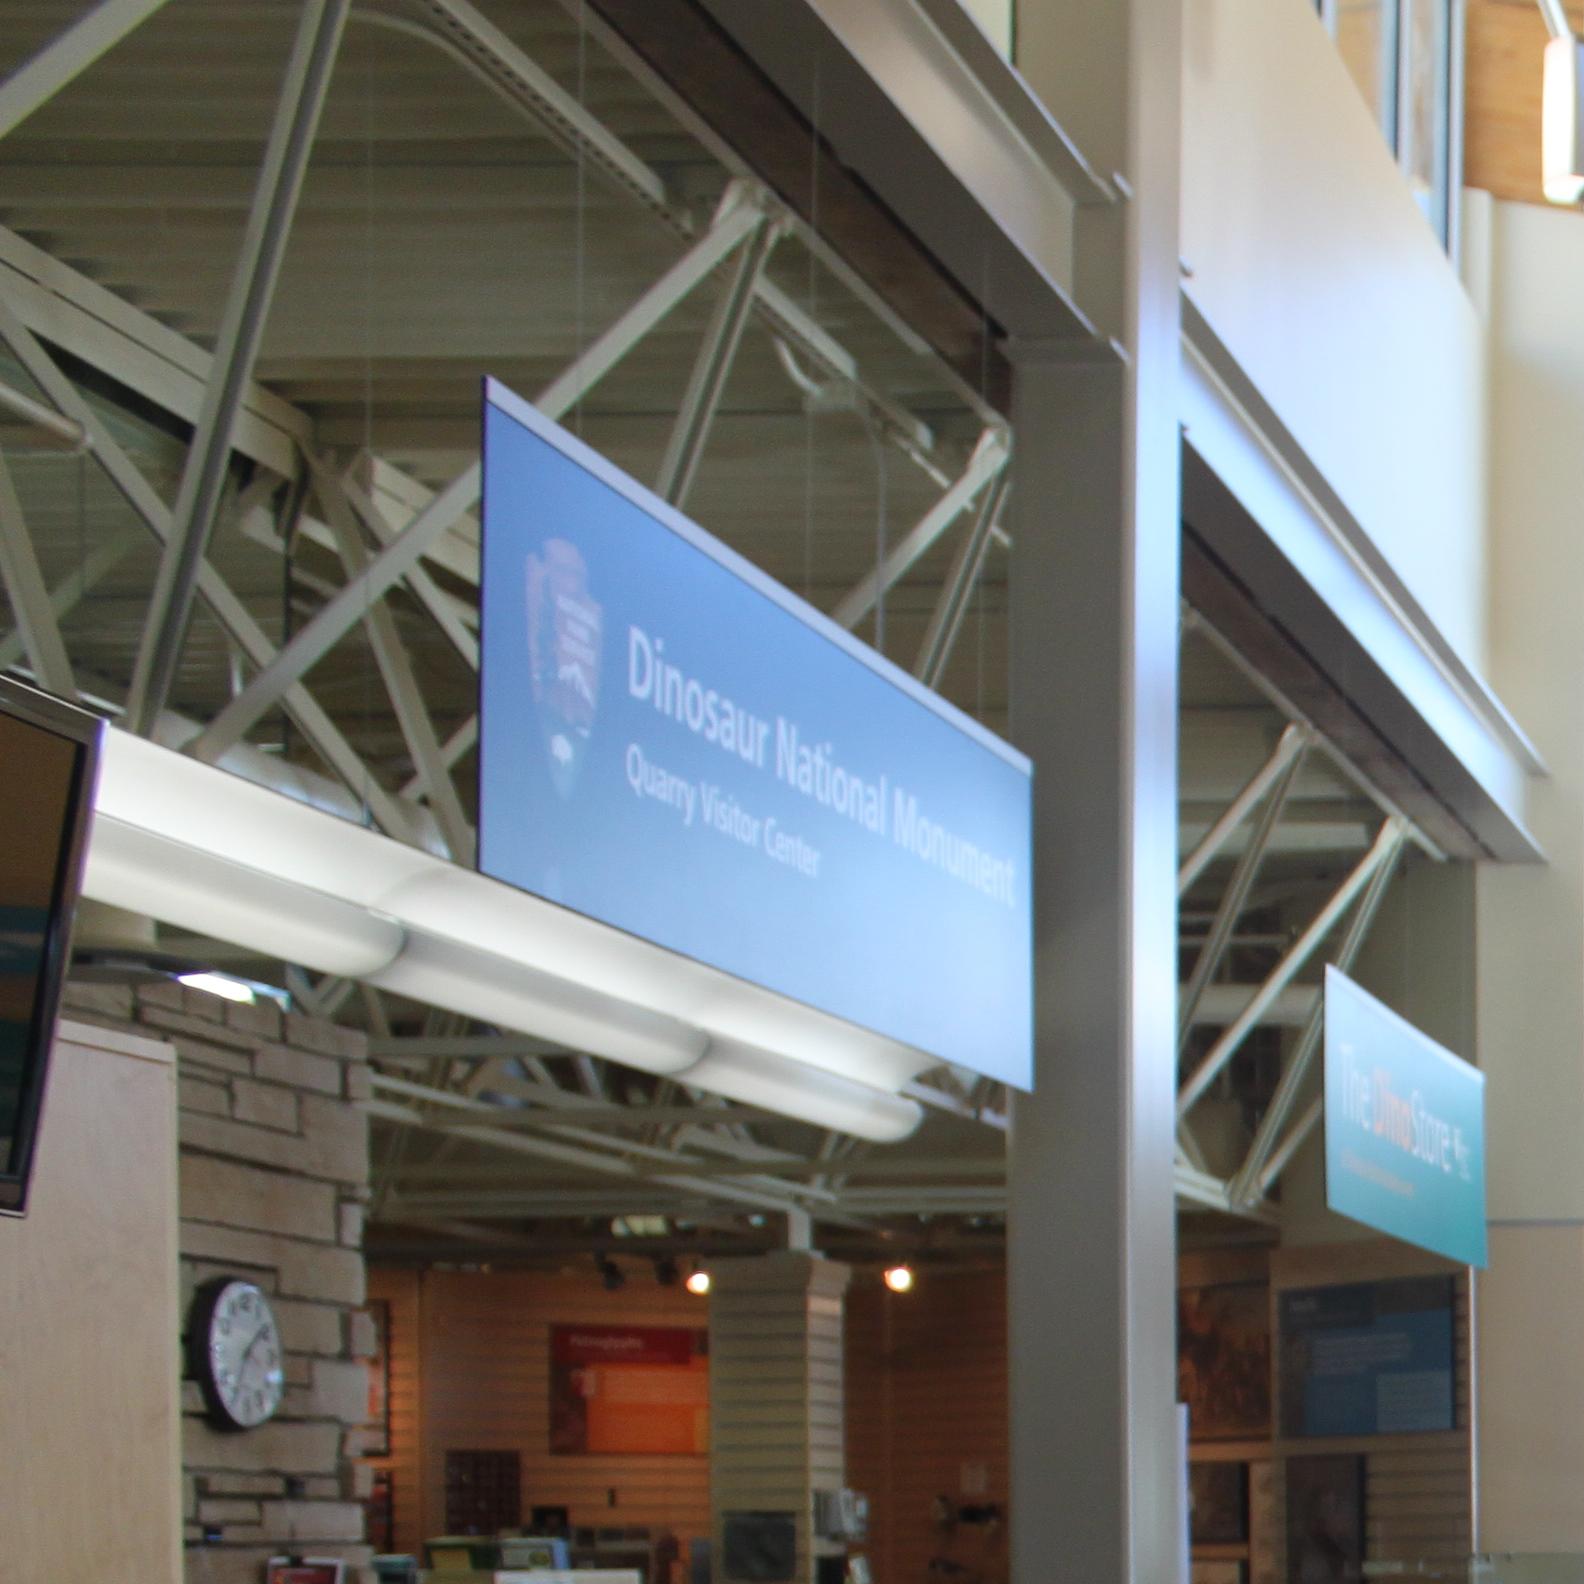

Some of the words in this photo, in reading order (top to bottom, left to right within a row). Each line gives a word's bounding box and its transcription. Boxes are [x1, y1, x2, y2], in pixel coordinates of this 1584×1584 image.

[626, 743, 698, 825] Quarry
[701, 781, 763, 847] Visitor
[764, 816, 821, 878] Center
[630, 625, 770, 767] Dinosaur
[777, 716, 886, 835] National
[895, 788, 1016, 908] Monument
